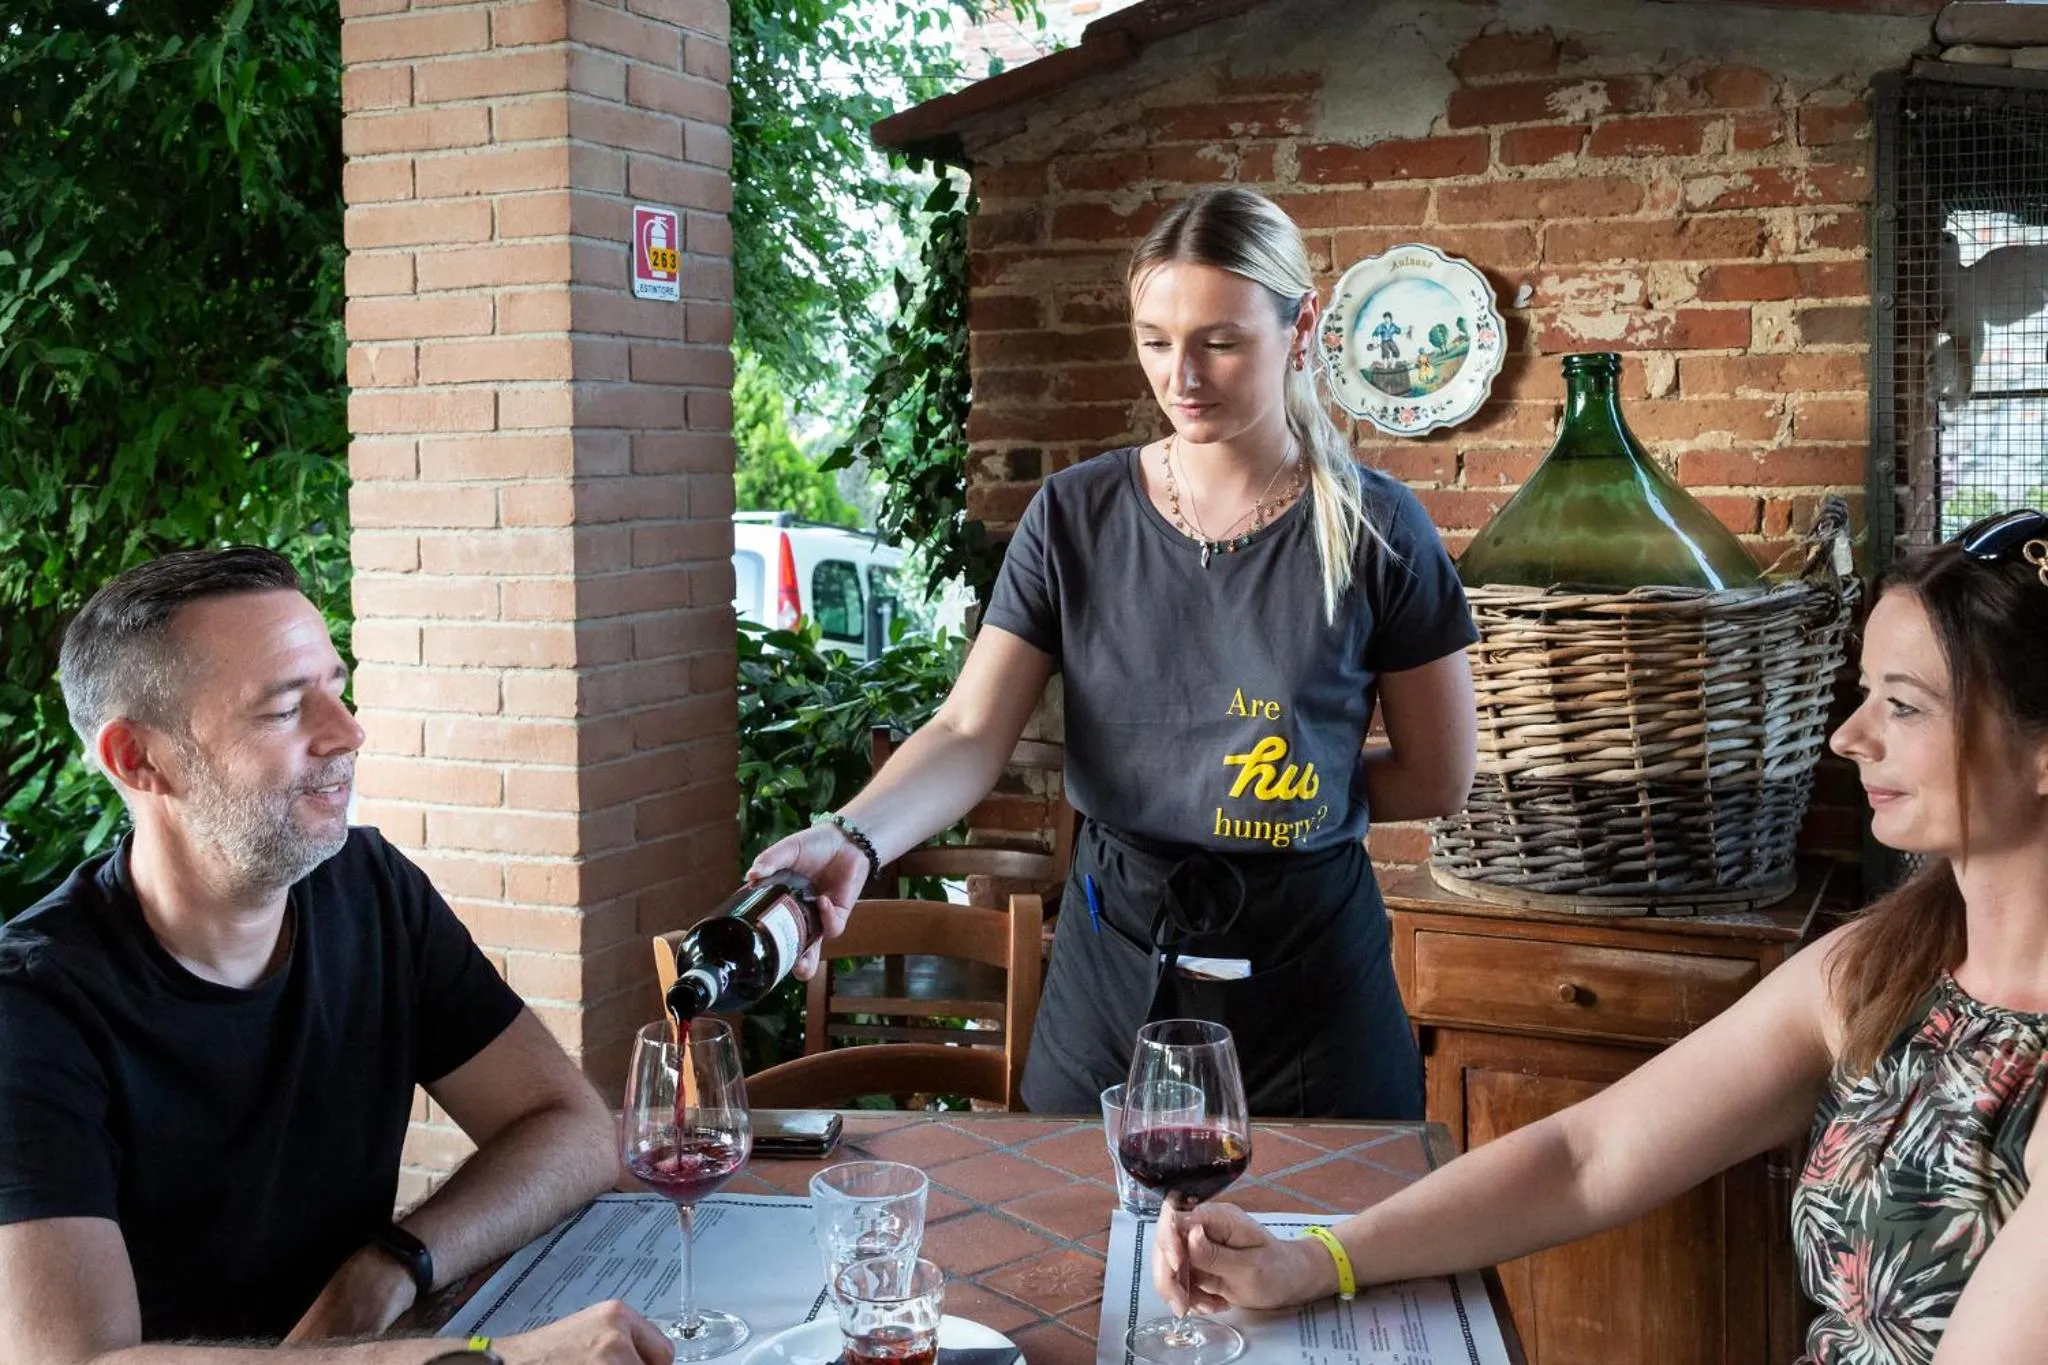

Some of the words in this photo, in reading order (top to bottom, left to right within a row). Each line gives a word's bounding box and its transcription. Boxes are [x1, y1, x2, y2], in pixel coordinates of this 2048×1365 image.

[652, 250, 677, 269] 263
[640, 283, 674, 295] ESTINTORE
[1225, 687, 1281, 721] Are
[1213, 805, 1328, 848] hungry?
